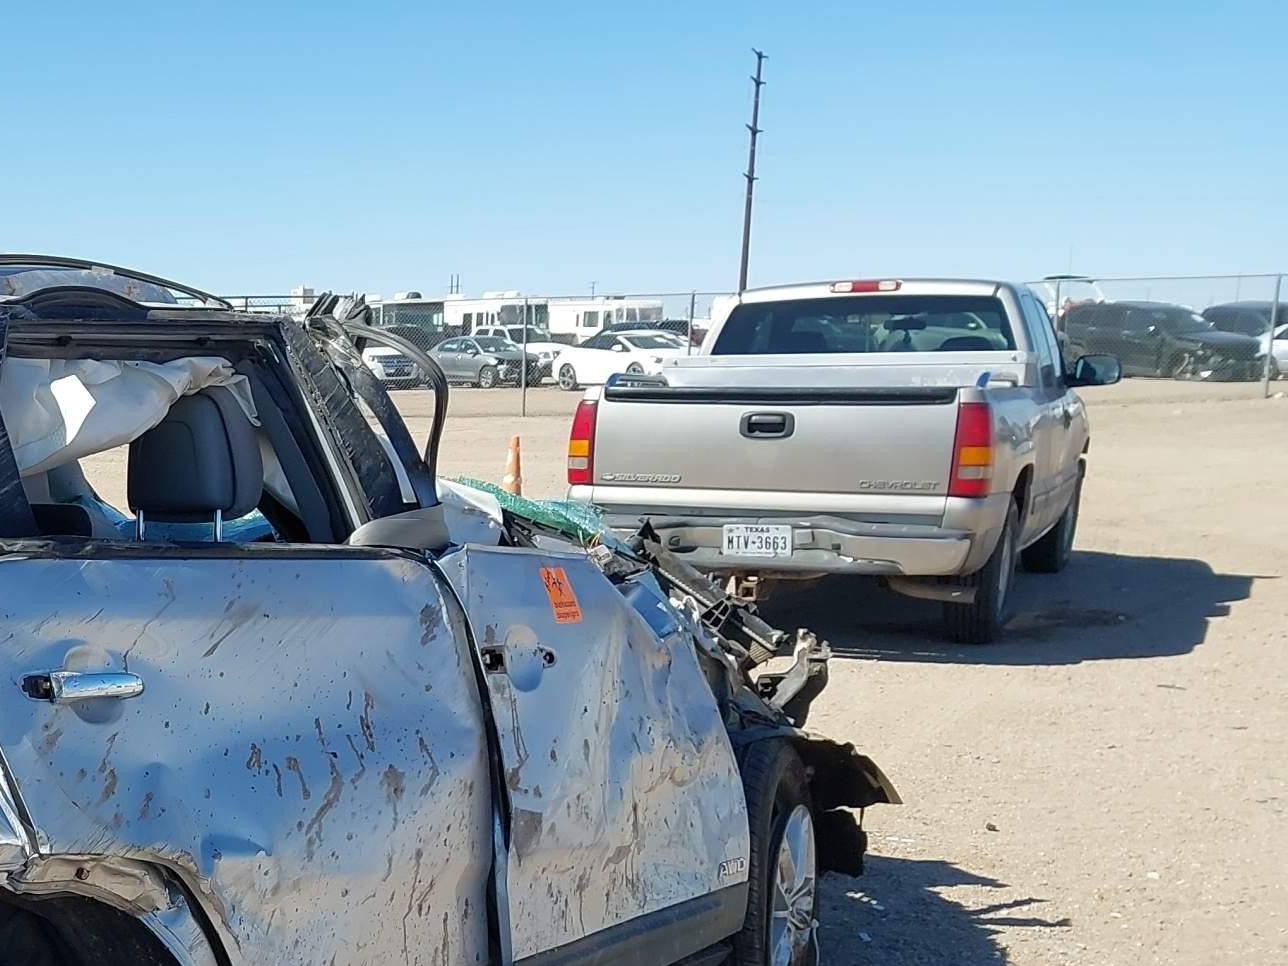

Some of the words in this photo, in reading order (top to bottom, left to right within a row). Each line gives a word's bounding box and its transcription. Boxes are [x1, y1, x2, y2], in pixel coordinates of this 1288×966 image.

[614, 473, 682, 483] SILVERADO
[858, 479, 940, 490] CHEVROLET
[744, 526, 770, 534] TEXAS
[718, 857, 746, 876] AWD
